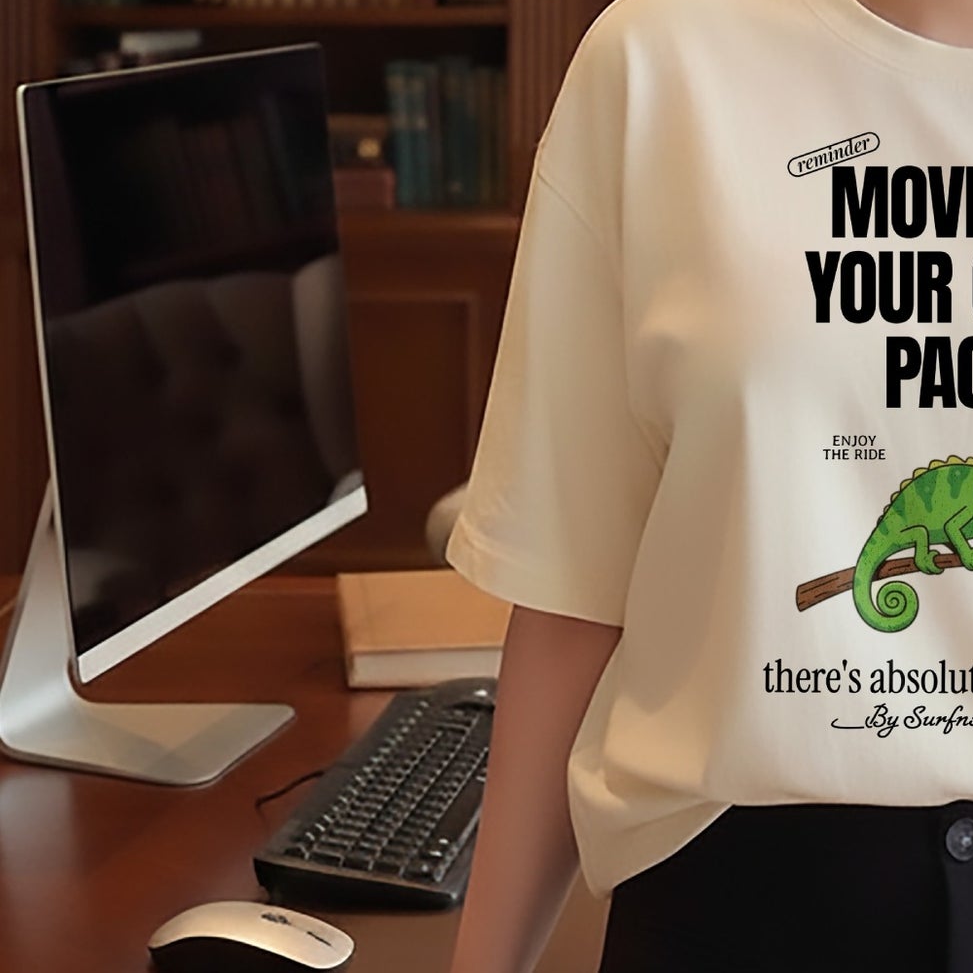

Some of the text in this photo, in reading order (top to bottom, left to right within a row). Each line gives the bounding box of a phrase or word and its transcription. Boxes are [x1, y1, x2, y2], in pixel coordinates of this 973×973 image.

[796, 135, 871, 173] reminder
[804, 250, 953, 324] YOUR
[822, 448, 886, 460] THE RIDE
[832, 434, 877, 447] ENJOY
[762, 658, 862, 694] there's
[864, 702, 899, 739] By
